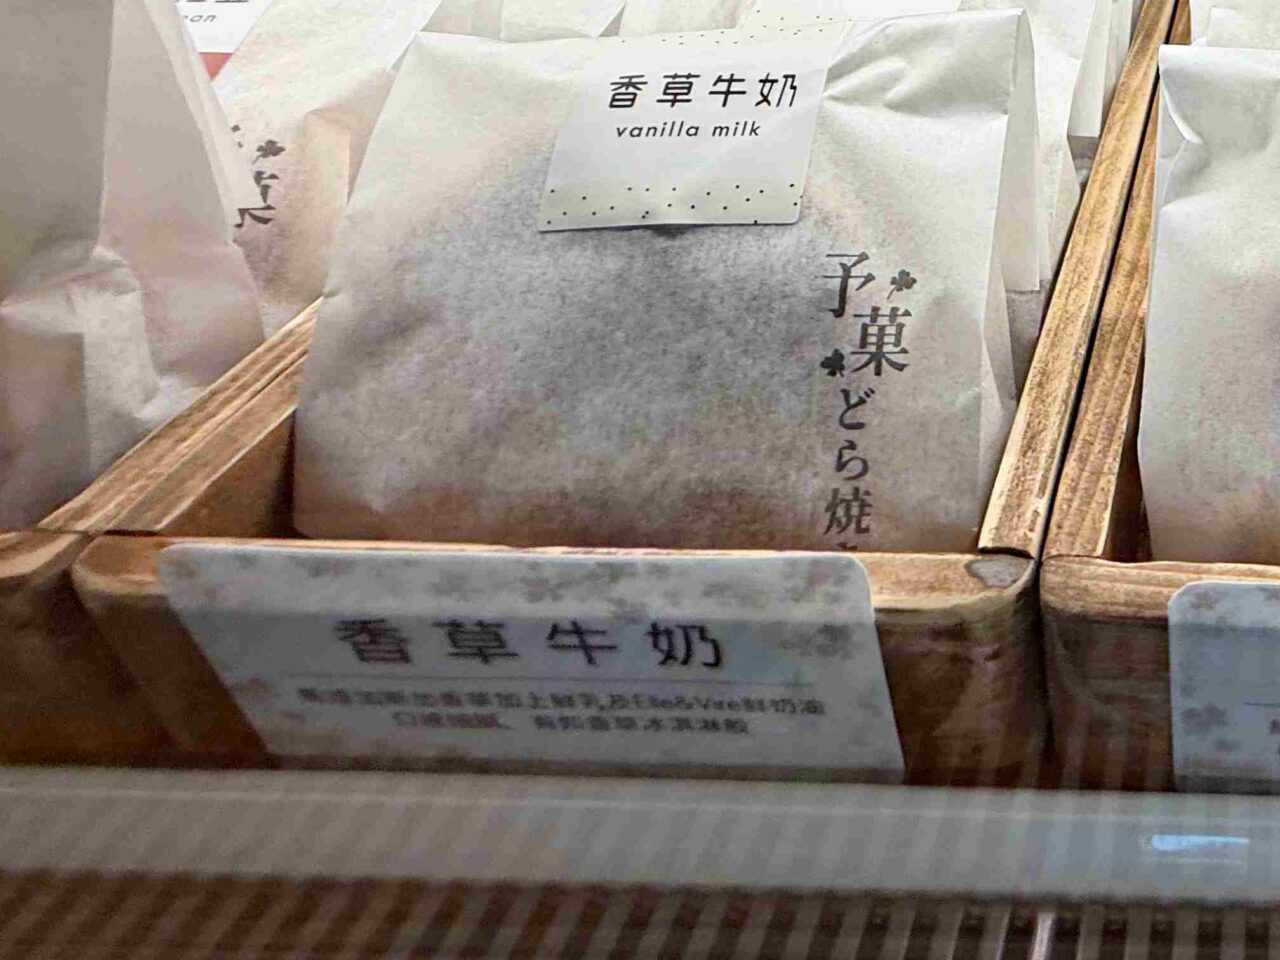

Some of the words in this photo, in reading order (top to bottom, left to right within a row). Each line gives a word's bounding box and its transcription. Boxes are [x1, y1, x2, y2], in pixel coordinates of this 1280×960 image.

[608, 72, 798, 109] 香草牛奶
[616, 120, 700, 138] vanilla
[711, 120, 762, 137] milk
[333, 618, 723, 669] 香草牛奶
